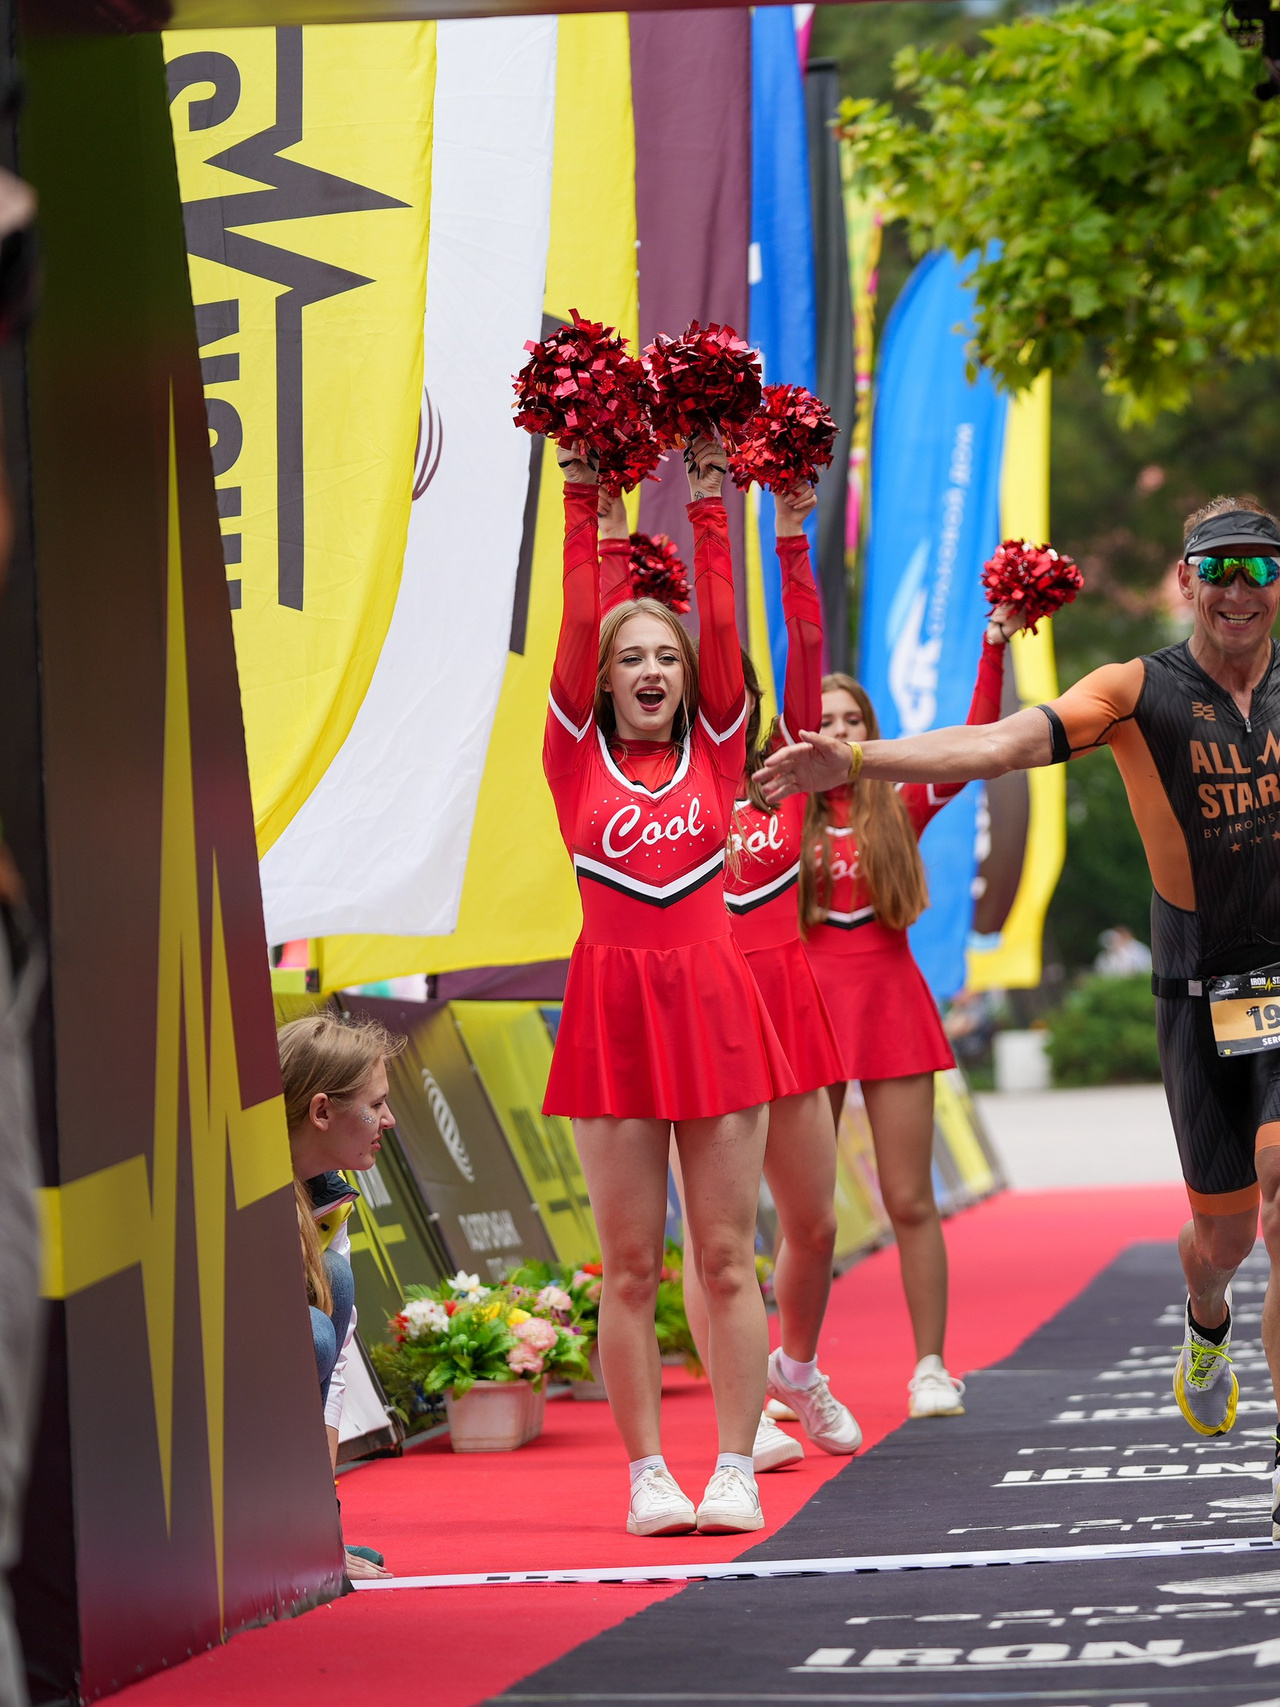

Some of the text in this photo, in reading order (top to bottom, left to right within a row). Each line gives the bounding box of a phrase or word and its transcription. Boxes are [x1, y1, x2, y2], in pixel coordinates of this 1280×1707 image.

[1190, 740, 1251, 774] ALL
[601, 796, 705, 859] Cool
[1203, 827, 1221, 839] BY
[1250, 977, 1266, 986] IRON
[1002, 1461, 1271, 1482] IRON
[804, 1639, 1184, 1666] IRON
